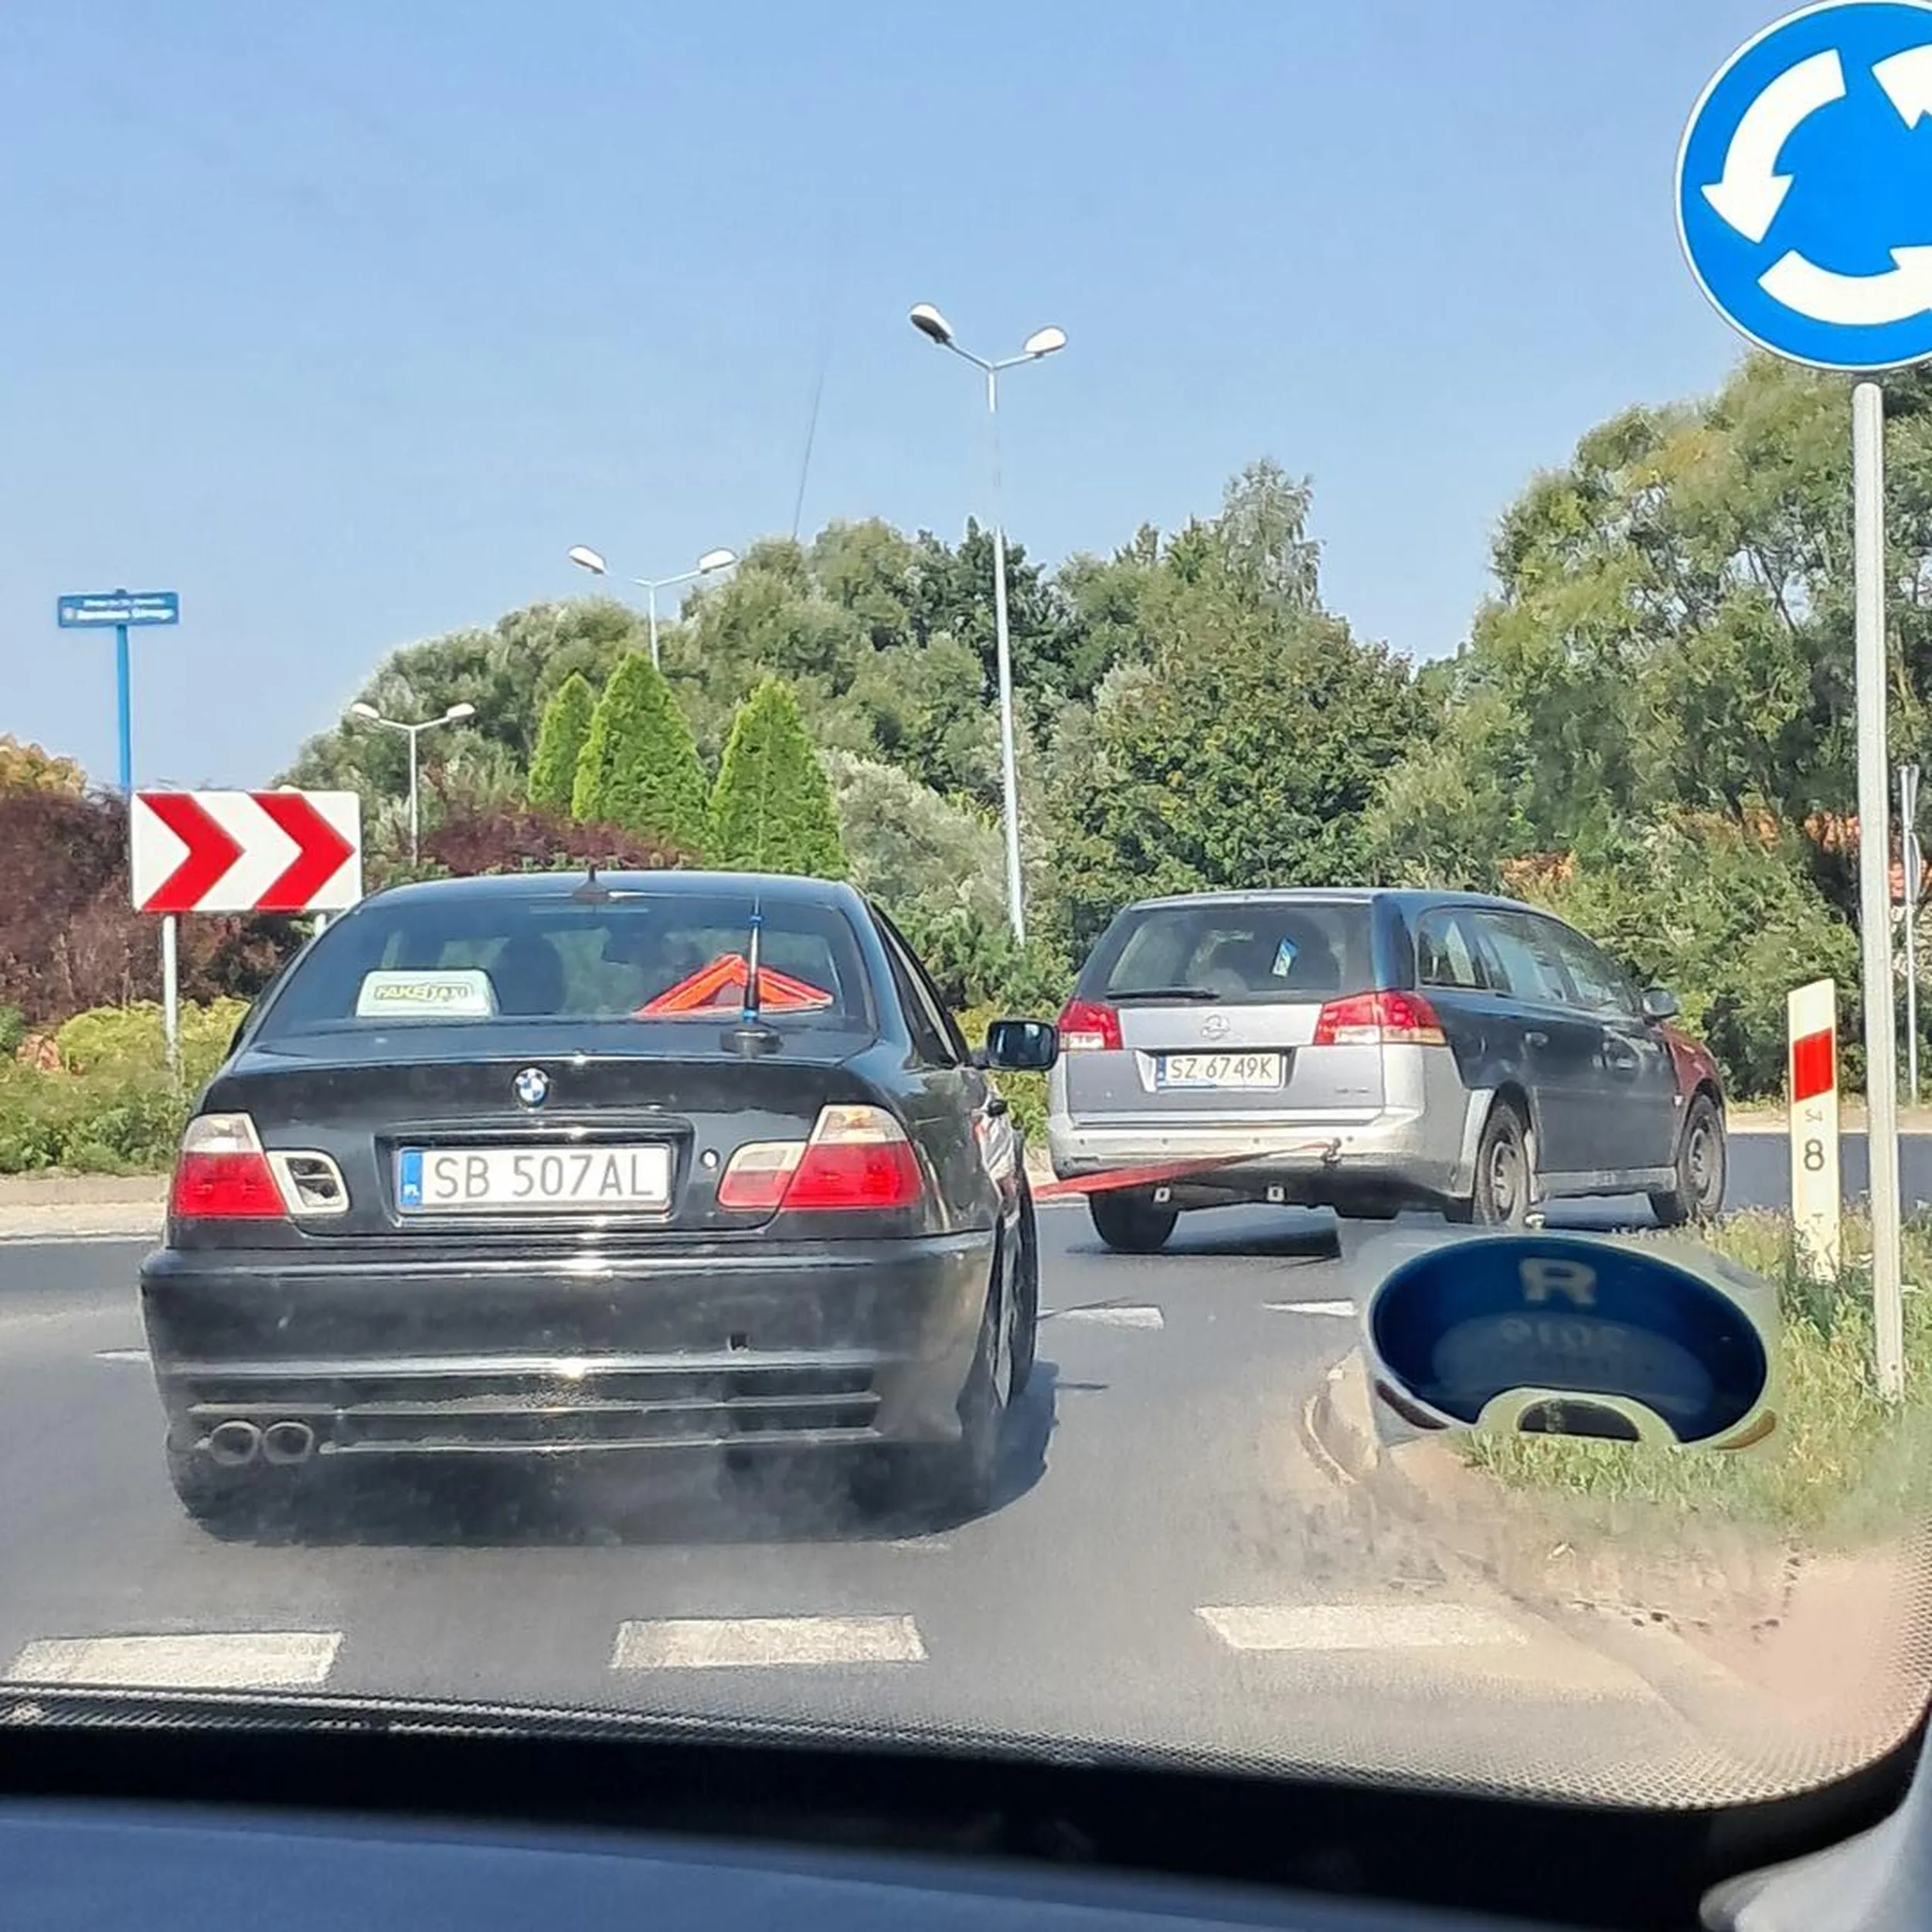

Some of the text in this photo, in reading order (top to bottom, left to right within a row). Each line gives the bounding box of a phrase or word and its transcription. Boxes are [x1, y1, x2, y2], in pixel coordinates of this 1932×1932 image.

[1171, 1056, 1272, 1080] SZ 6749K
[1803, 1138, 1825, 1172] 8
[434, 1154, 654, 1199] SB 507AL
